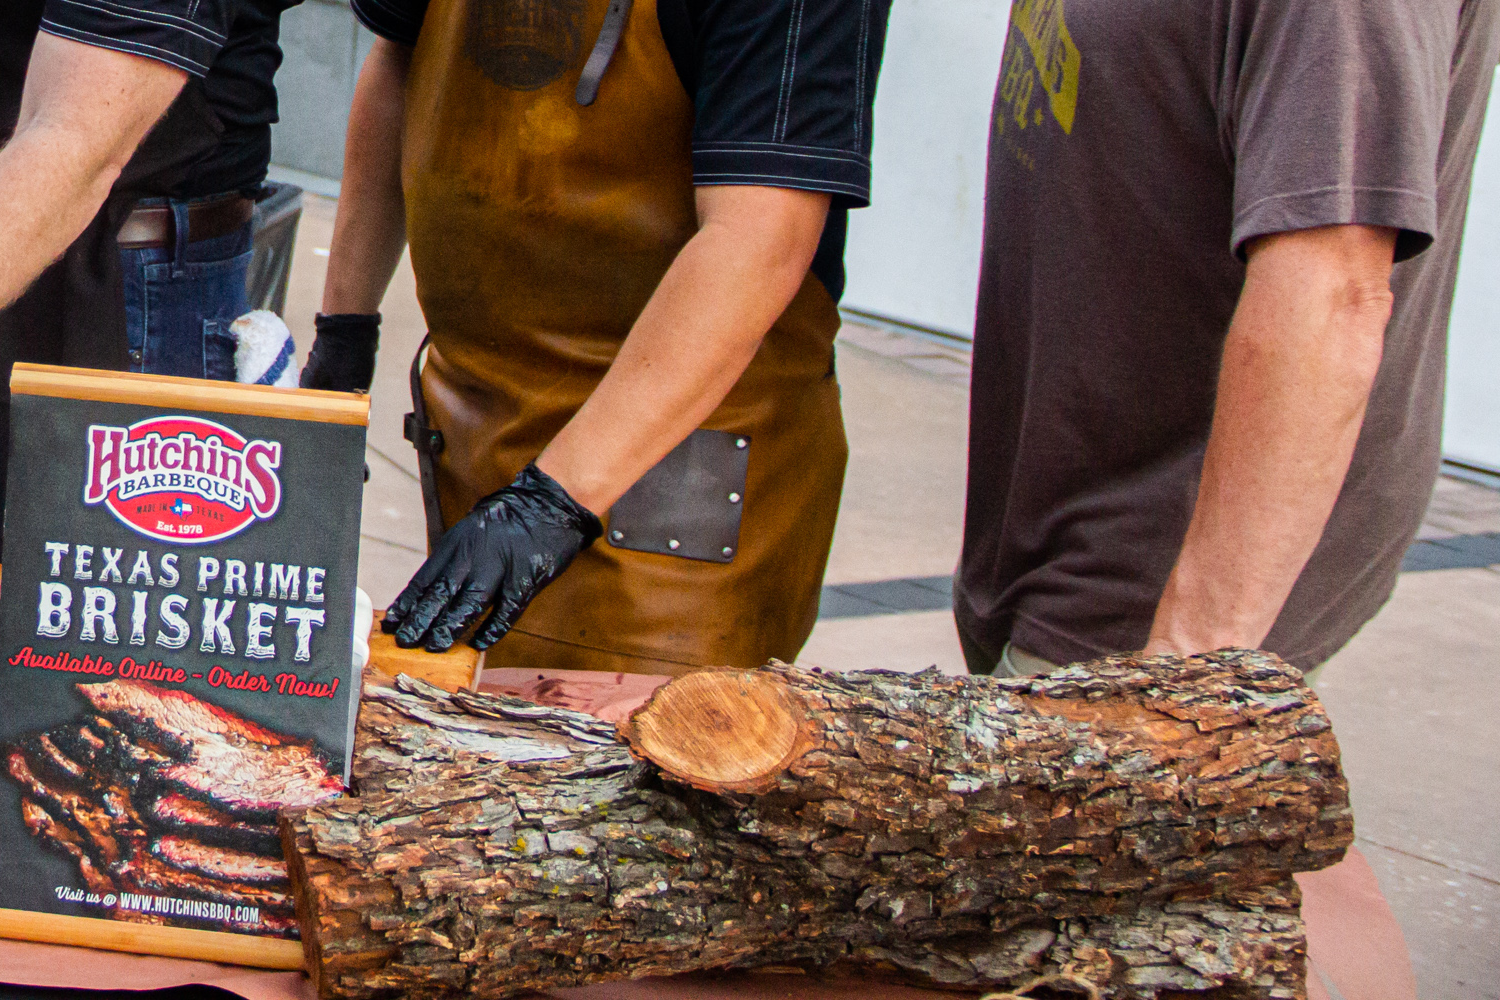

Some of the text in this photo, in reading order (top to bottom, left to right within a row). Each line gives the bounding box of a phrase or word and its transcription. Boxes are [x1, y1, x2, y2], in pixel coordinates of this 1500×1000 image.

[123, 473, 242, 506] BARBEQUE
[136, 504, 156, 515] MADE
[159, 503, 168, 512] IN
[156, 520, 204, 535] Est. 1978
[44, 541, 327, 603] TEXAS PRIME
[36, 581, 326, 663] BRISKET
[8, 647, 115, 676] Available
[118, 656, 188, 684] Online
[207, 665, 273, 693] Order
[275, 673, 340, 699] Now!
[55, 886, 260, 924] Visit us @ WWW.HUTCHINSBBQ.COM
